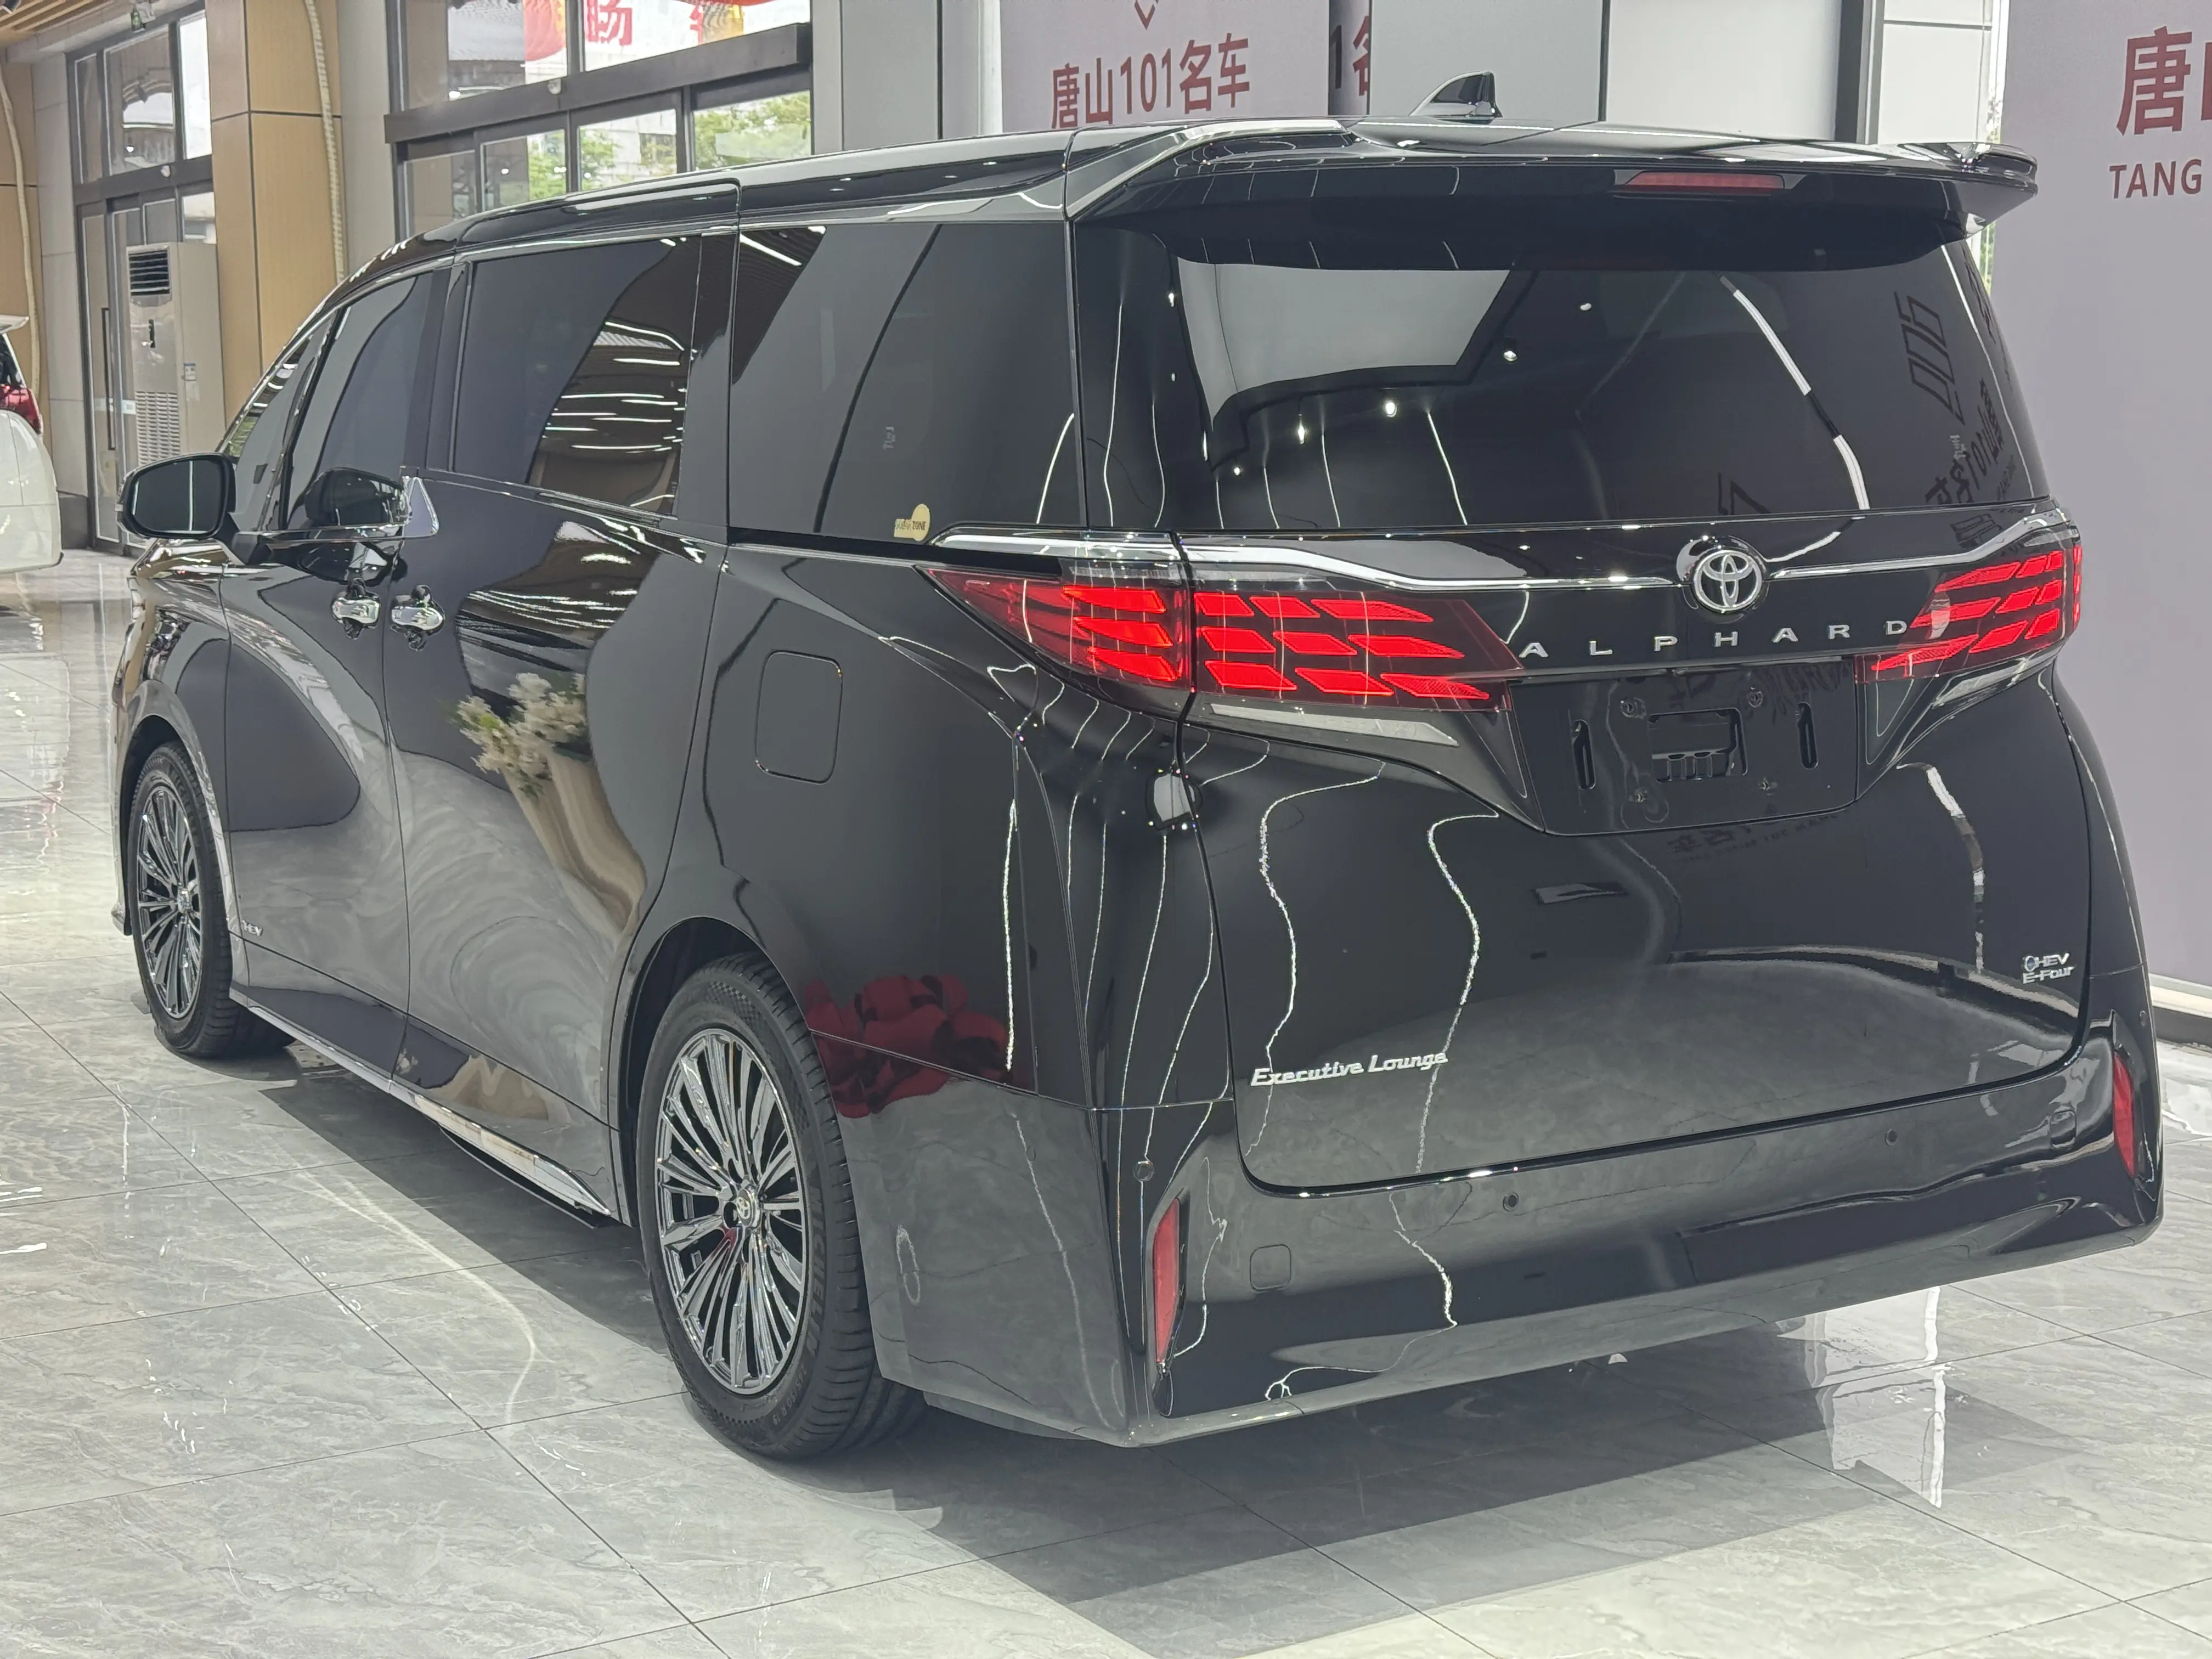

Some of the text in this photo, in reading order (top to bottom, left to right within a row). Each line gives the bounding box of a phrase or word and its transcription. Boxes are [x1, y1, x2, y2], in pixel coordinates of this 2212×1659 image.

[1052, 32, 1250, 129] 唐山101名车
[2116, 25, 2212, 136] 唐
[2109, 159, 2202, 199] TANG
[1519, 619, 1908, 658] ALPHARD
[2023, 966, 2075, 984] E-Four
[1250, 1052, 1448, 1086] Executive Lounge
[805, 1187, 827, 1358] MICHELIN
